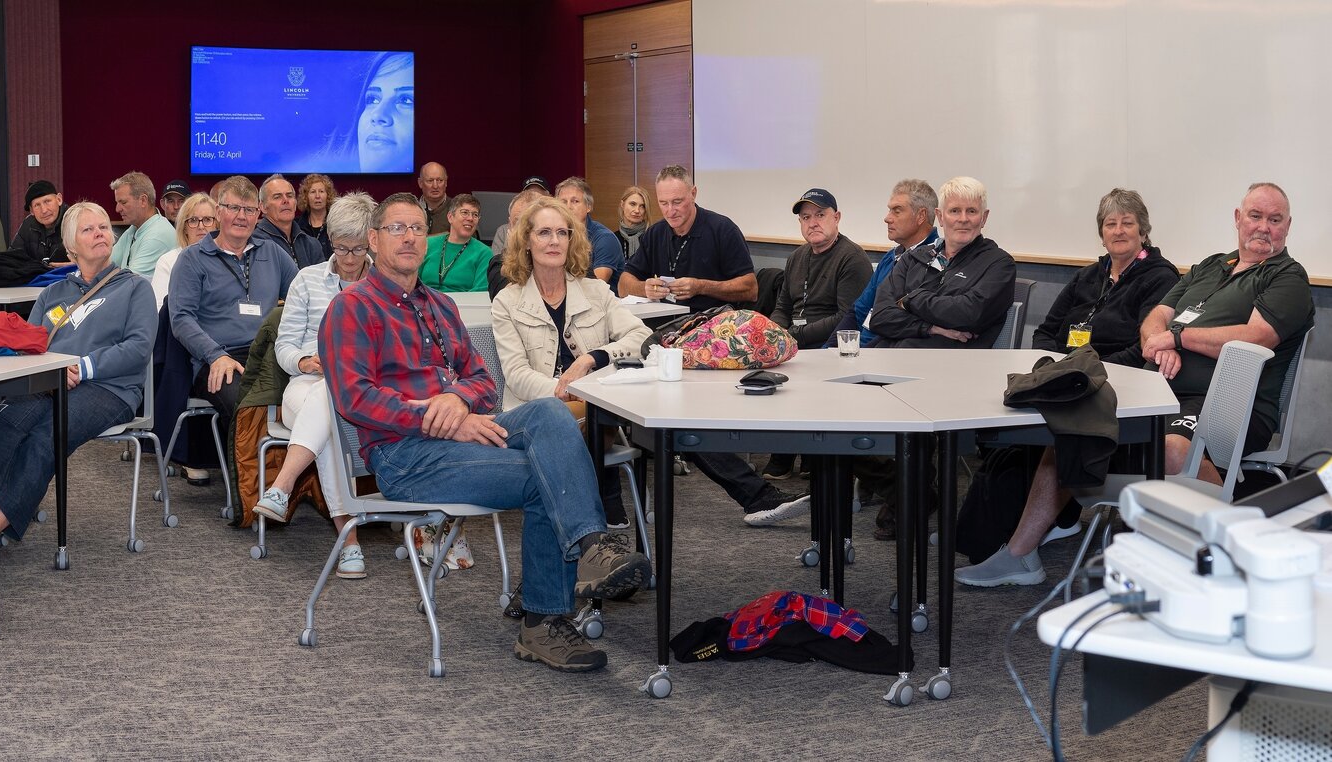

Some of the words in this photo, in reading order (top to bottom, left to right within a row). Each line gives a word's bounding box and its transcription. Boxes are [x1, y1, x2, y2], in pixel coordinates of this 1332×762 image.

[195, 132, 227, 146] 11:40
[194, 150, 216, 160] Friday,
[218, 150, 225, 158] 12
[227, 150, 242, 160] April
